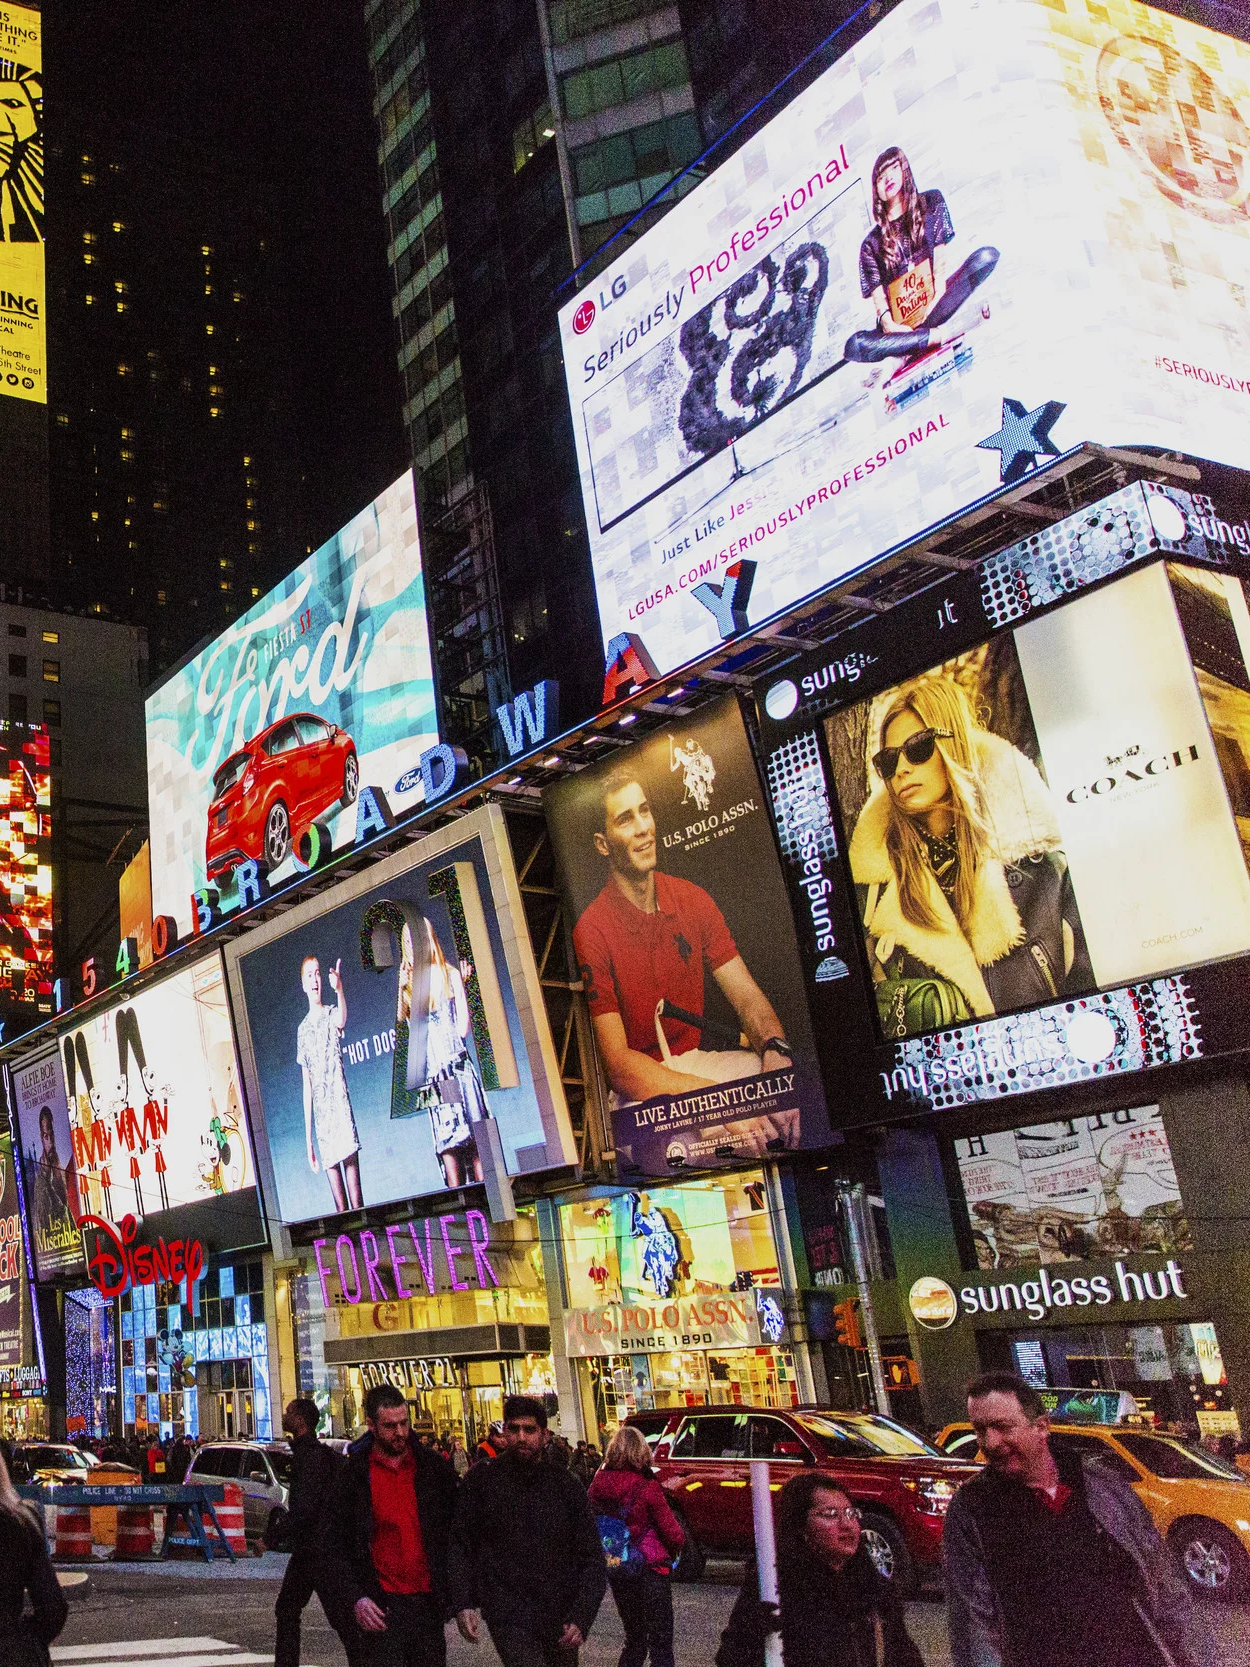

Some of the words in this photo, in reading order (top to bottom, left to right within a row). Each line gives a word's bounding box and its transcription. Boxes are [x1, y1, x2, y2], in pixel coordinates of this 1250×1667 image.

[0, 11, 10, 22] IS
[0, 44, 18, 55] TIMES
[584, 285, 685, 384] Seriously
[689, 143, 850, 295] Professional
[600, 274, 627, 312] LG
[902, 273, 917, 293] 40
[900, 291, 929, 320] Dating
[15, 362, 42, 376] Street
[628, 412, 951, 621] LGUSA.COM/SERIOUSLYPROFESSIONAL
[661, 537, 691, 565] Just
[694, 515, 726, 542] Like
[263, 622, 297, 664] FIESTA
[399, 770, 422, 792] Ford
[1066, 744, 1201, 804] COACH
[662, 831, 685, 848] U.S.
[685, 815, 719, 839] POLO
[722, 798, 759, 824] ASSN.
[684, 835, 710, 851] SINCE
[713, 825, 735, 839] 1890
[799, 826, 836, 951] sunglass
[1141, 926, 1203, 950] COACH.COM
[21, 1068, 40, 1091] ALFIE
[40, 1061, 56, 1080] BOE
[22, 1086, 38, 1102] BRINGS
[43, 1077, 57, 1094] HOME
[25, 1100, 32, 1111] TO
[635, 1105, 667, 1127] LIVE
[669, 1074, 795, 1119] AUTHENTICALLY
[706, 1111, 722, 1121] YEAR
[723, 1108, 735, 1117] OLD
[736, 1105, 752, 1114] POLO
[753, 1099, 778, 1110] PLAYER
[688, 1138, 719, 1150] OFFICIALLY
[49, 1213, 62, 1232] Les
[313, 1209, 500, 1308] FOREVER
[960, 1269, 1111, 1321] sunglass
[1114, 1259, 1187, 1302] hut
[582, 1308, 619, 1336] U.S.
[621, 1304, 680, 1331] POLO
[686, 1297, 754, 1327] ASSN.
[620, 1336, 666, 1349] SINCE
[672, 1333, 712, 1346] 1890
[359, 1358, 436, 1391] FOREVER
[435, 1357, 459, 1387] 21
[82, 1487, 101, 1495] POLICE
[104, 1486, 117, 1495] LINE
[168, 1537, 185, 1545] POLICE
